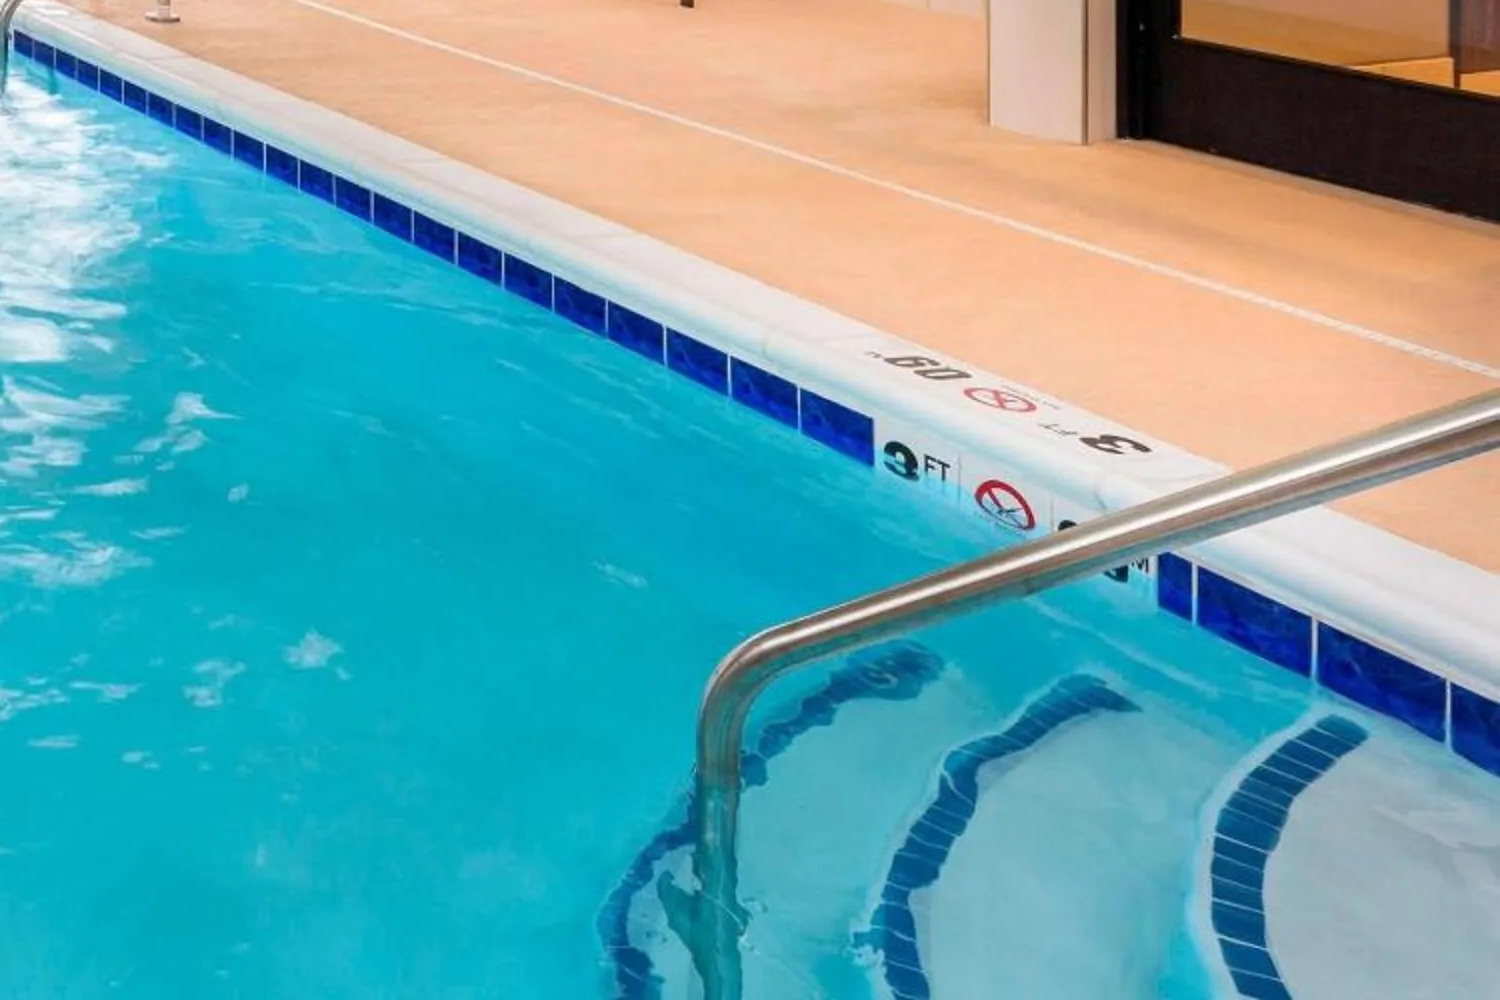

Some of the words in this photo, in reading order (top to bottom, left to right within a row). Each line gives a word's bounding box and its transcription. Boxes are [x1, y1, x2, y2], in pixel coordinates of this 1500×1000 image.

[1080, 434, 1152, 455] 3
[884, 441, 919, 481] 3
[924, 454, 951, 482] FT
